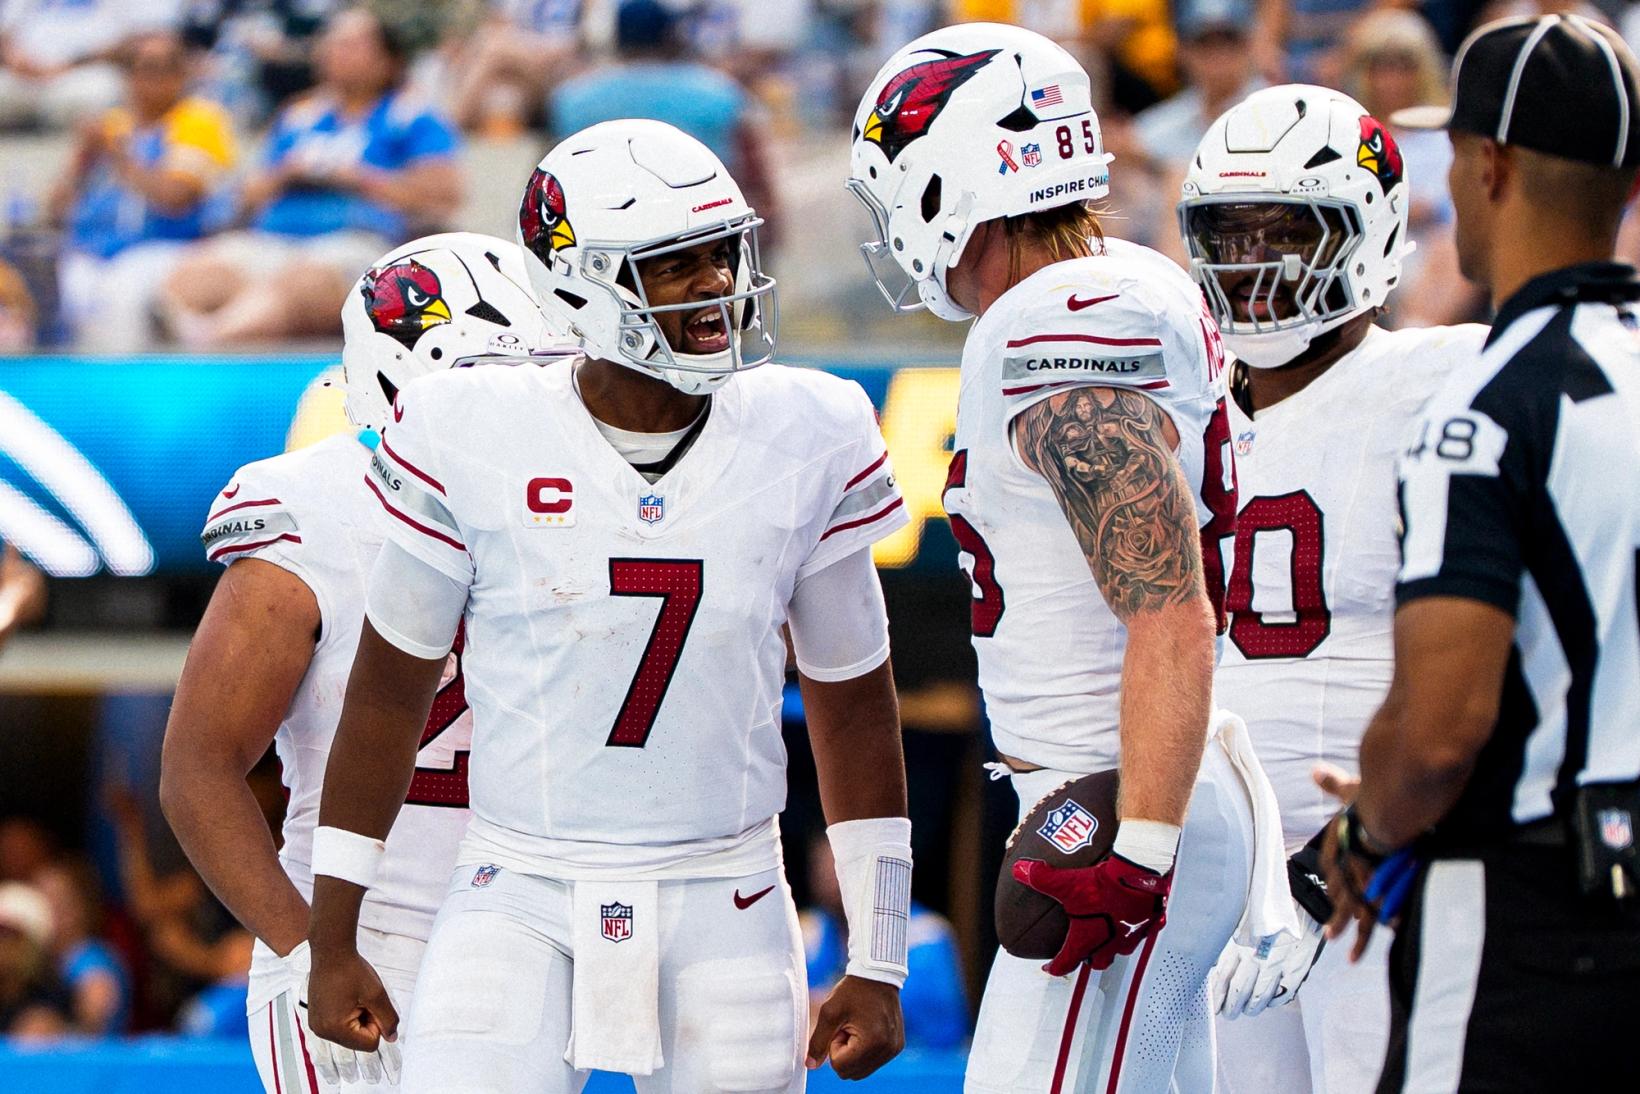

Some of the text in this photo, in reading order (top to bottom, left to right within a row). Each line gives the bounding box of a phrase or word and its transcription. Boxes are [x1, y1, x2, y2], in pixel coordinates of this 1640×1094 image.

[1029, 179, 1085, 204] INSPIRE
[1026, 358, 1140, 373] CARDINALS
[526, 477, 573, 513] C
[1227, 489, 1331, 660] 0
[605, 557, 704, 748] 7
[1054, 814, 1092, 848] NFL
[604, 919, 629, 937] NFL
